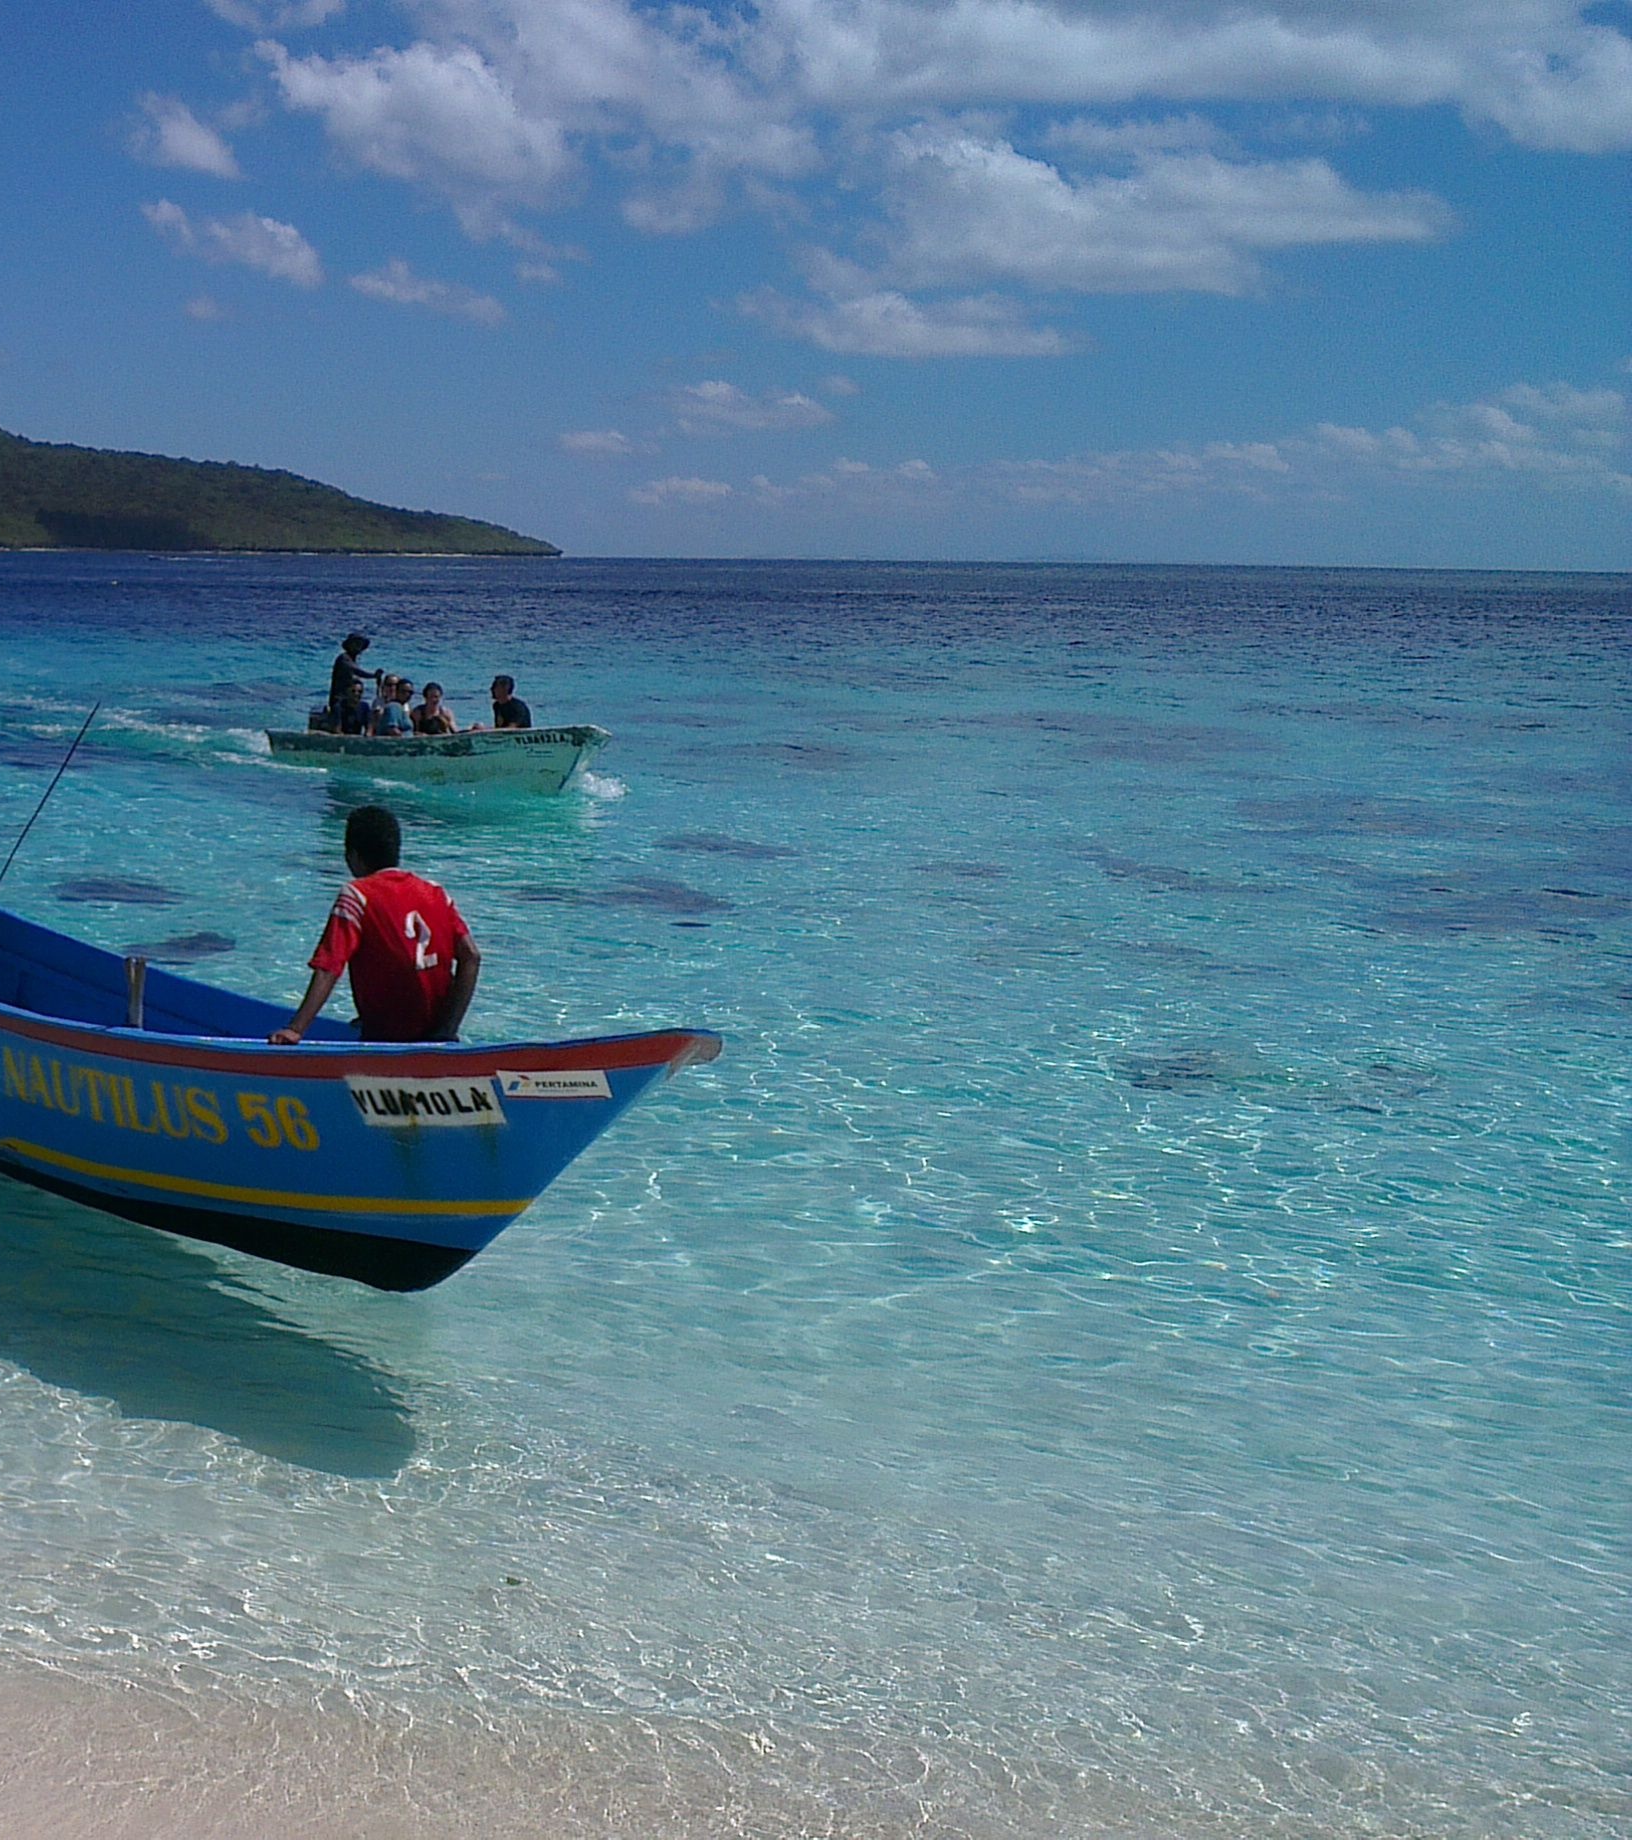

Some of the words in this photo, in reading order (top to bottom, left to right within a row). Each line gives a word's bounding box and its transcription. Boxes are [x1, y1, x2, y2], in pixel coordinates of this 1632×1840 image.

[404, 910, 438, 970] 2
[3, 1046, 229, 1145] NAUTILUS
[237, 1091, 320, 1151] 56
[534, 1081, 598, 1089] PERTAMINA
